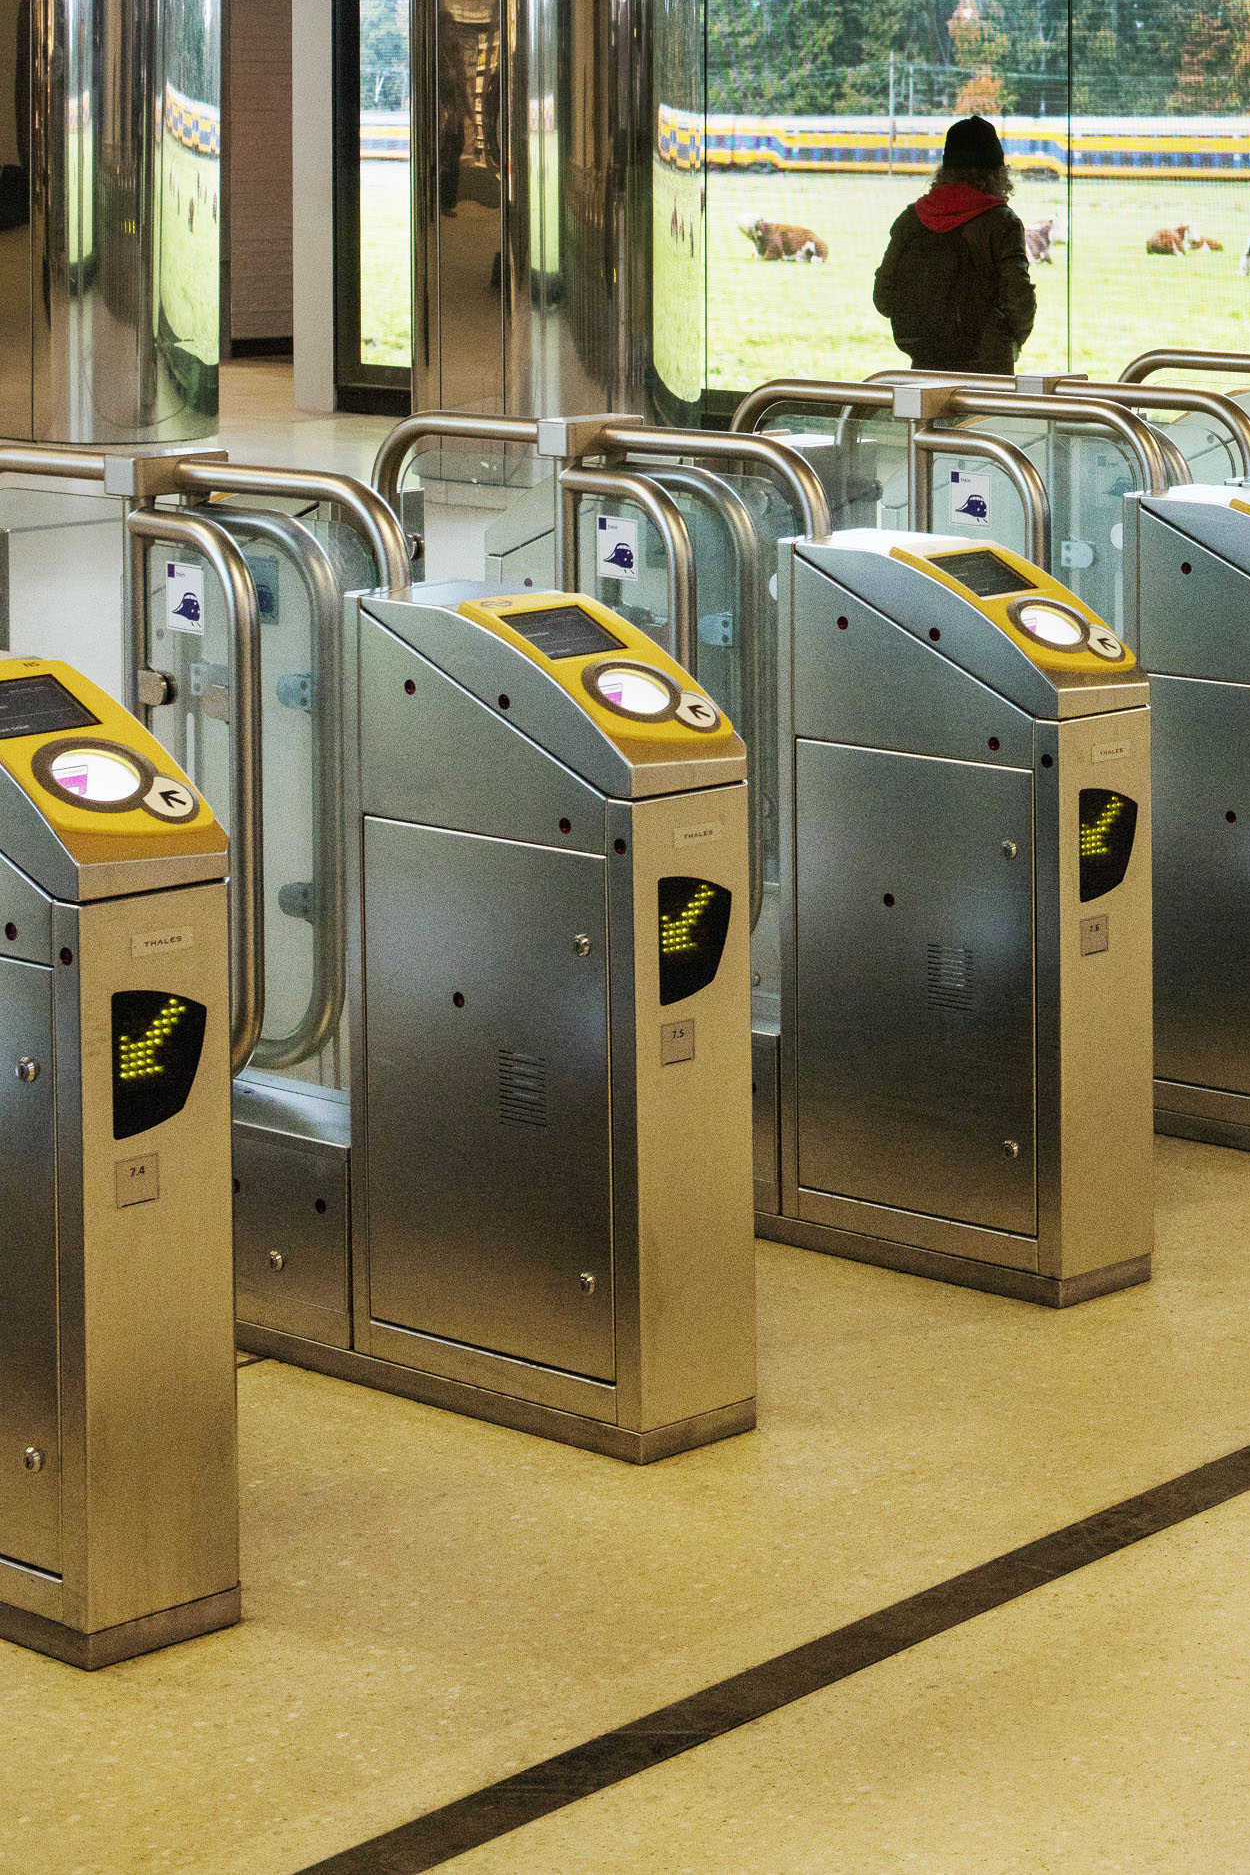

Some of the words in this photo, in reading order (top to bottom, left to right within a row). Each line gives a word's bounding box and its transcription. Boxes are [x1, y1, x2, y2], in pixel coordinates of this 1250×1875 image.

[144, 936, 182, 947] THALES
[672, 1029, 685, 1039] 7.5
[130, 1165, 146, 1177] 7.4
